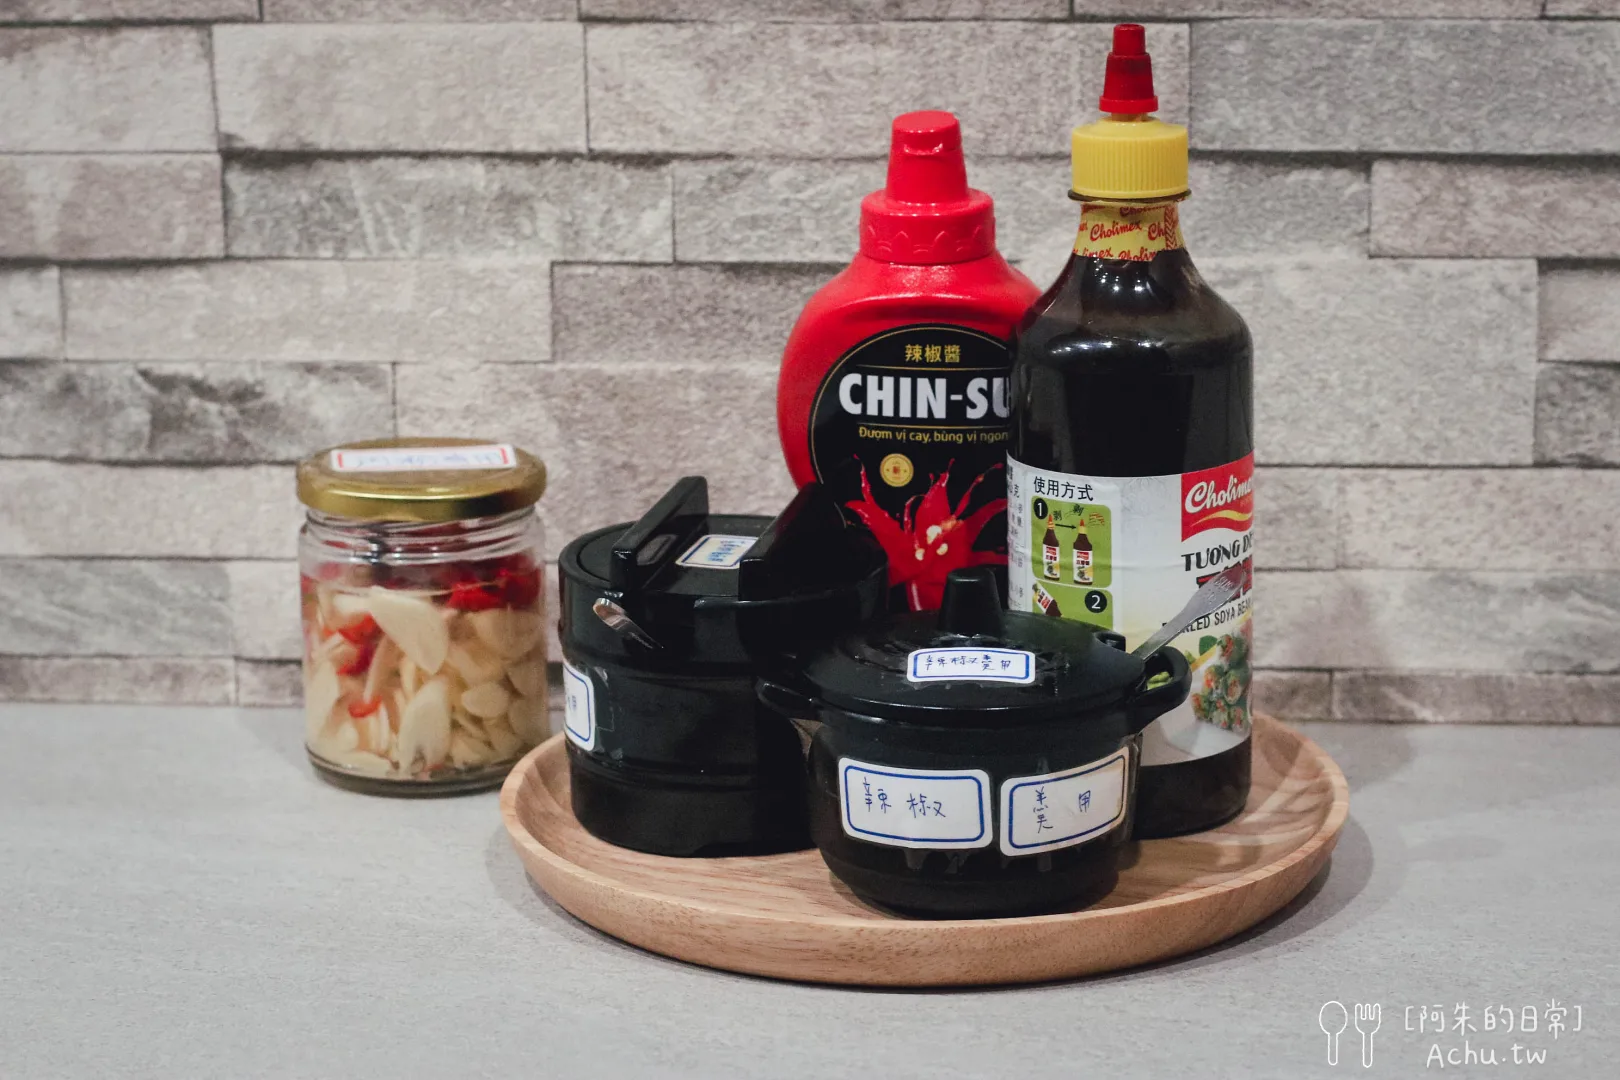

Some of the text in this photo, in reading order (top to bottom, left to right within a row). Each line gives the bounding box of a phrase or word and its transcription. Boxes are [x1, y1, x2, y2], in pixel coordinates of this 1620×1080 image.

[1090, 219, 1142, 241] Cholimex
[904, 344, 961, 363] 辣椒醬
[1034, 476, 1093, 501] 使用方式
[1037, 503, 1043, 517] 1
[1091, 595, 1101, 609] 2
[1214, 607, 1236, 625] SOYA
